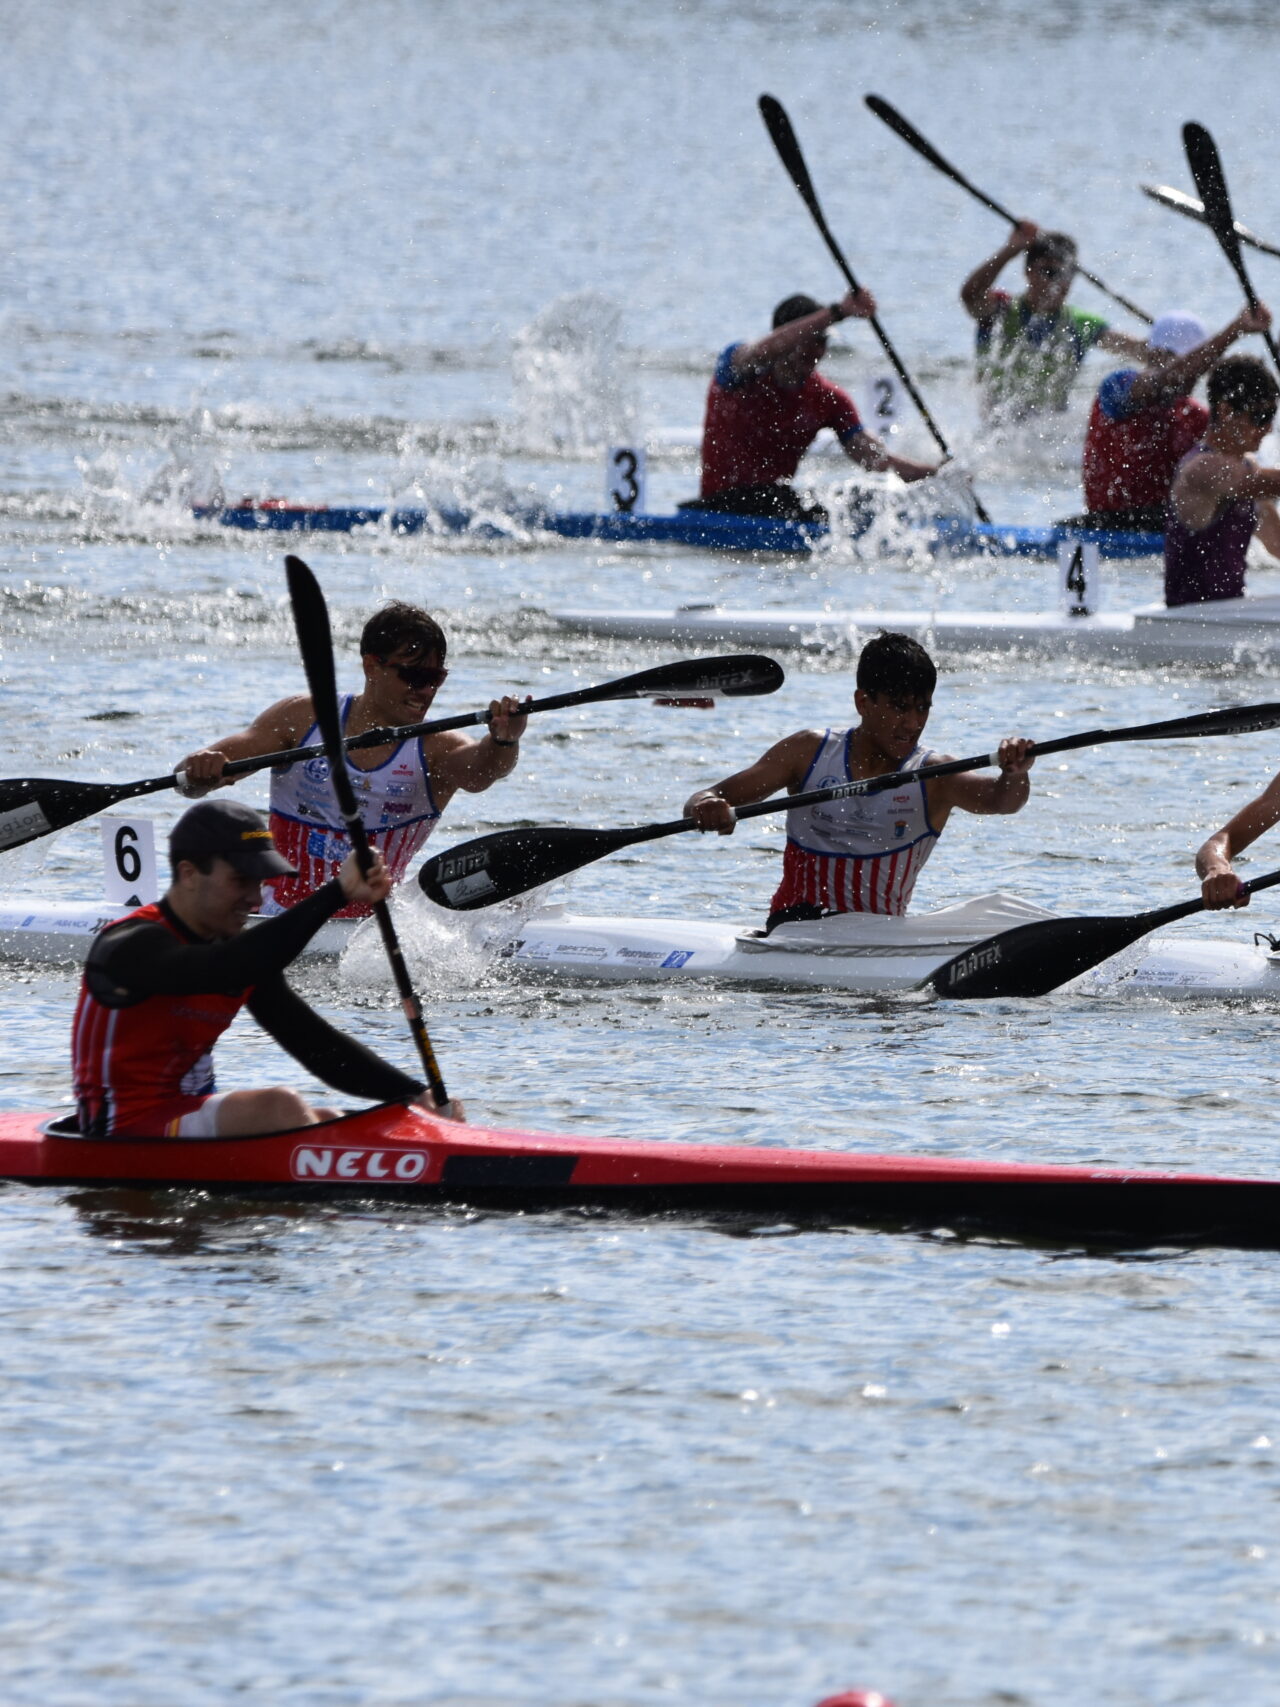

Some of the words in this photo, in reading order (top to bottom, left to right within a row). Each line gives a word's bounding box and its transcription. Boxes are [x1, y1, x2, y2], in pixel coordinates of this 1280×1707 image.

[874, 379, 895, 417] 2
[612, 448, 639, 508] 3
[1066, 545, 1086, 602] 4
[114, 825, 142, 882] 6
[296, 1149, 425, 1178] NELO
